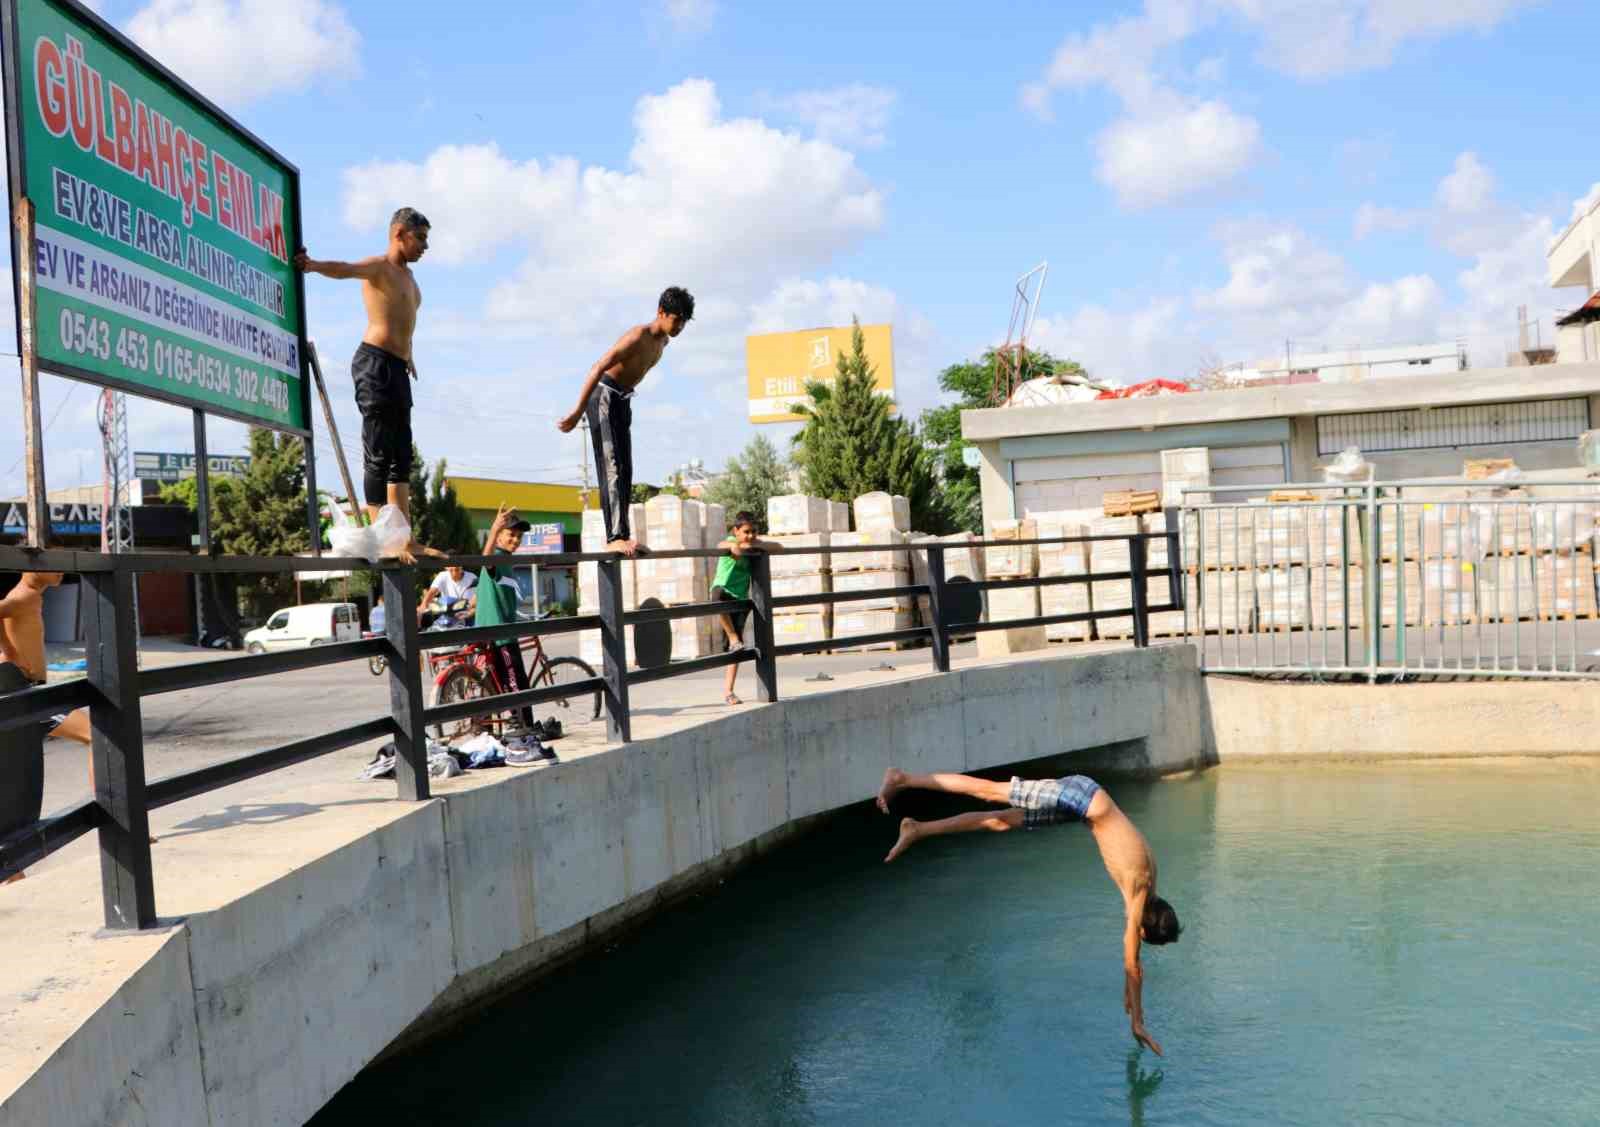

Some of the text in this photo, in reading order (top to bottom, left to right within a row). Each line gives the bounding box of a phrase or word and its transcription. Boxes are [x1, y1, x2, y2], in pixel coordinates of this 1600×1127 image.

[34, 33, 288, 265] GÜLBAHÇE EMLAK
[53, 167, 132, 247] EV&VE
[135, 208, 186, 271] ARSA
[35, 238, 58, 280] EV
[63, 247, 86, 289] VE
[90, 259, 151, 313] ARSANIZ
[154, 286, 220, 339] DEĞERİNDE
[222, 314, 258, 354] NAKİTE
[60, 308, 111, 361] 0543
[116, 328, 149, 371] 453
[235, 367, 258, 403] 302
